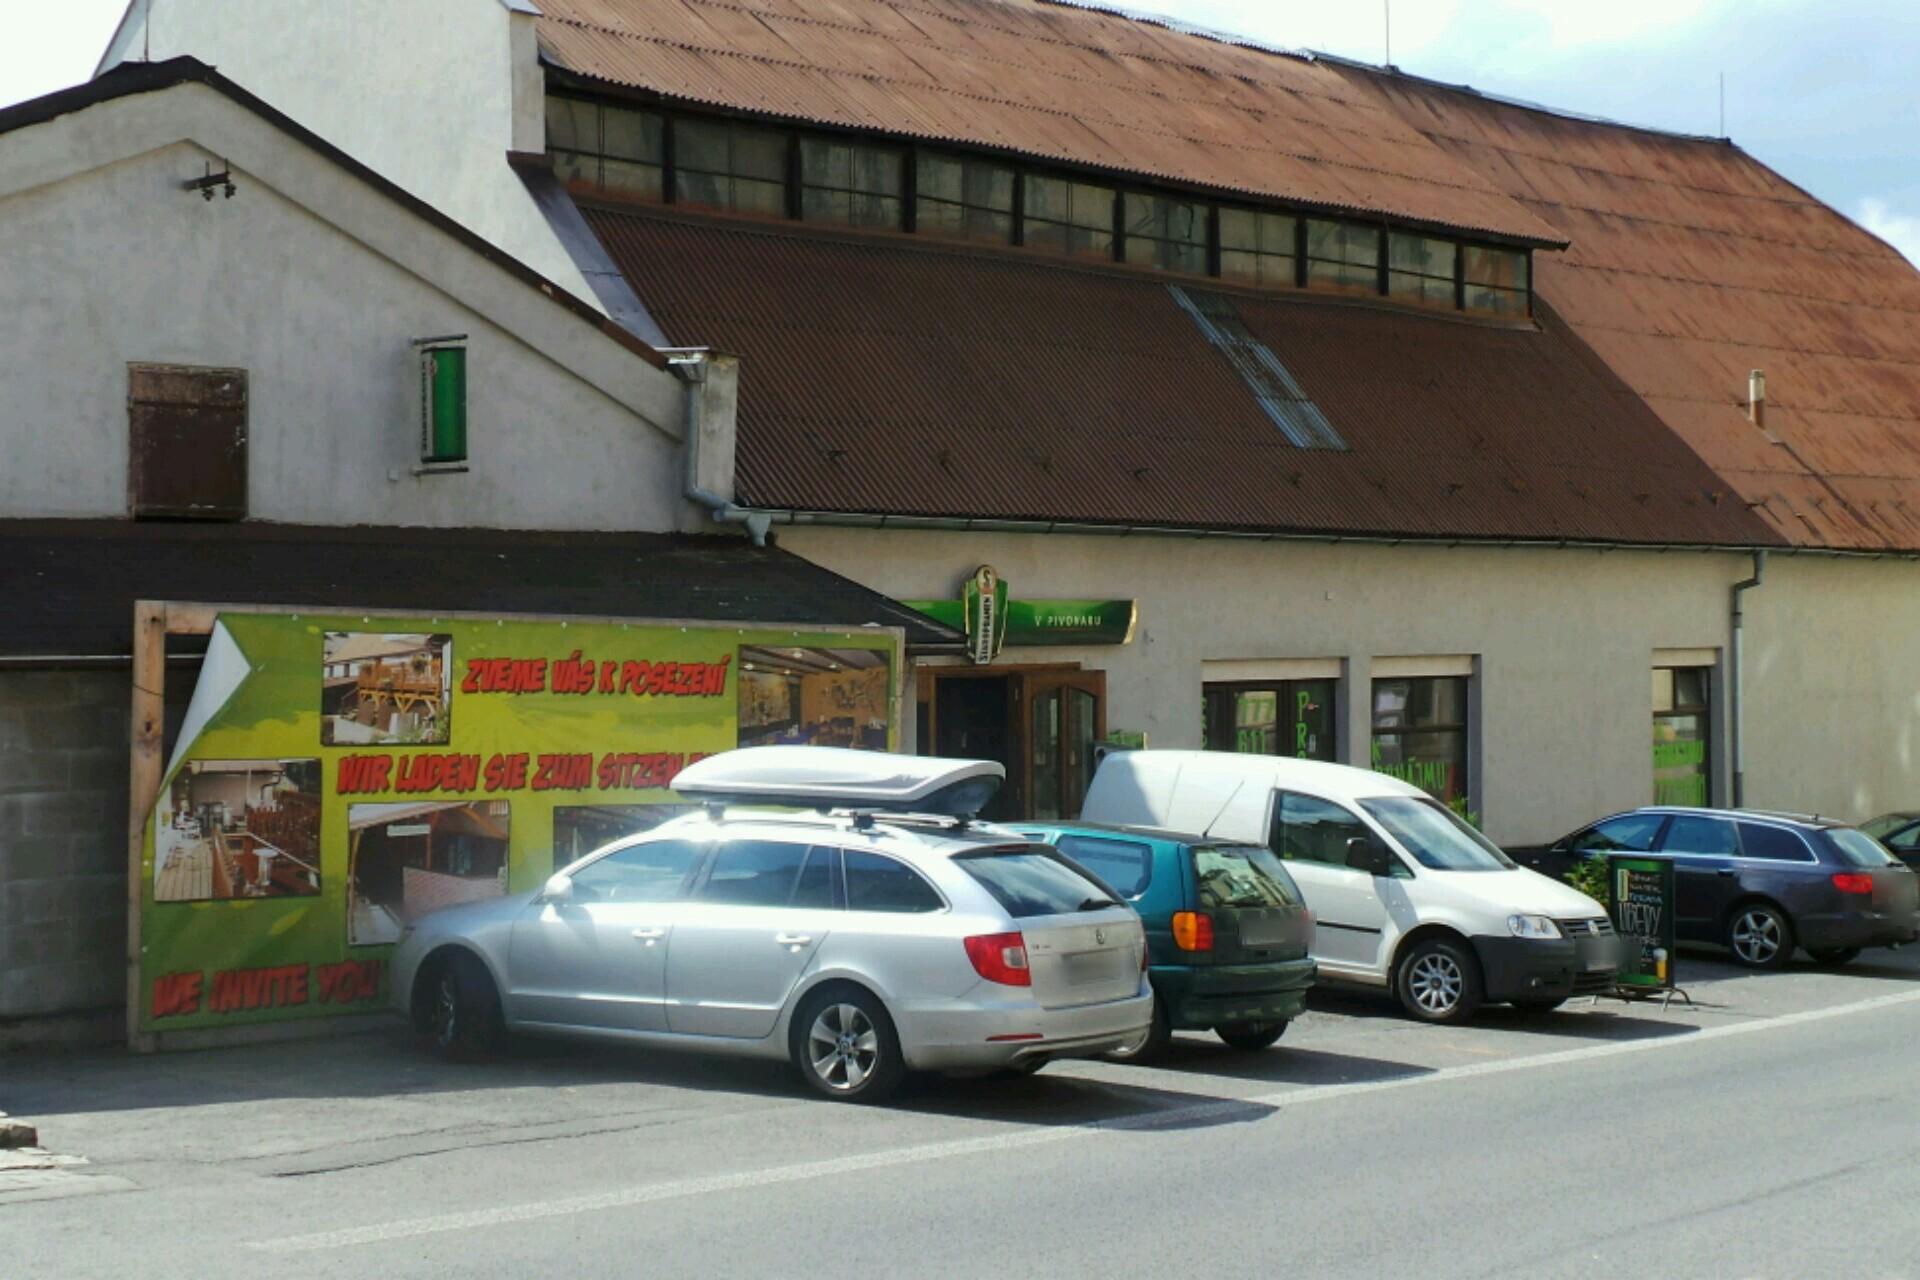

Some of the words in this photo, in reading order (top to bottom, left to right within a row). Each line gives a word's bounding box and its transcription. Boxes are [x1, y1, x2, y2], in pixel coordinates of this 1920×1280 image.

[462, 657, 547, 694] ZVEME
[552, 649, 595, 695] VÁS
[599, 657, 617, 694] K
[619, 654, 732, 696] POSEZENÍ
[337, 754, 392, 794] WIR
[396, 752, 480, 793] LADEN
[484, 752, 529, 791] SIE
[531, 752, 593, 791] ZUM
[153, 970, 204, 1018] WE
[208, 963, 310, 1013] INVITE
